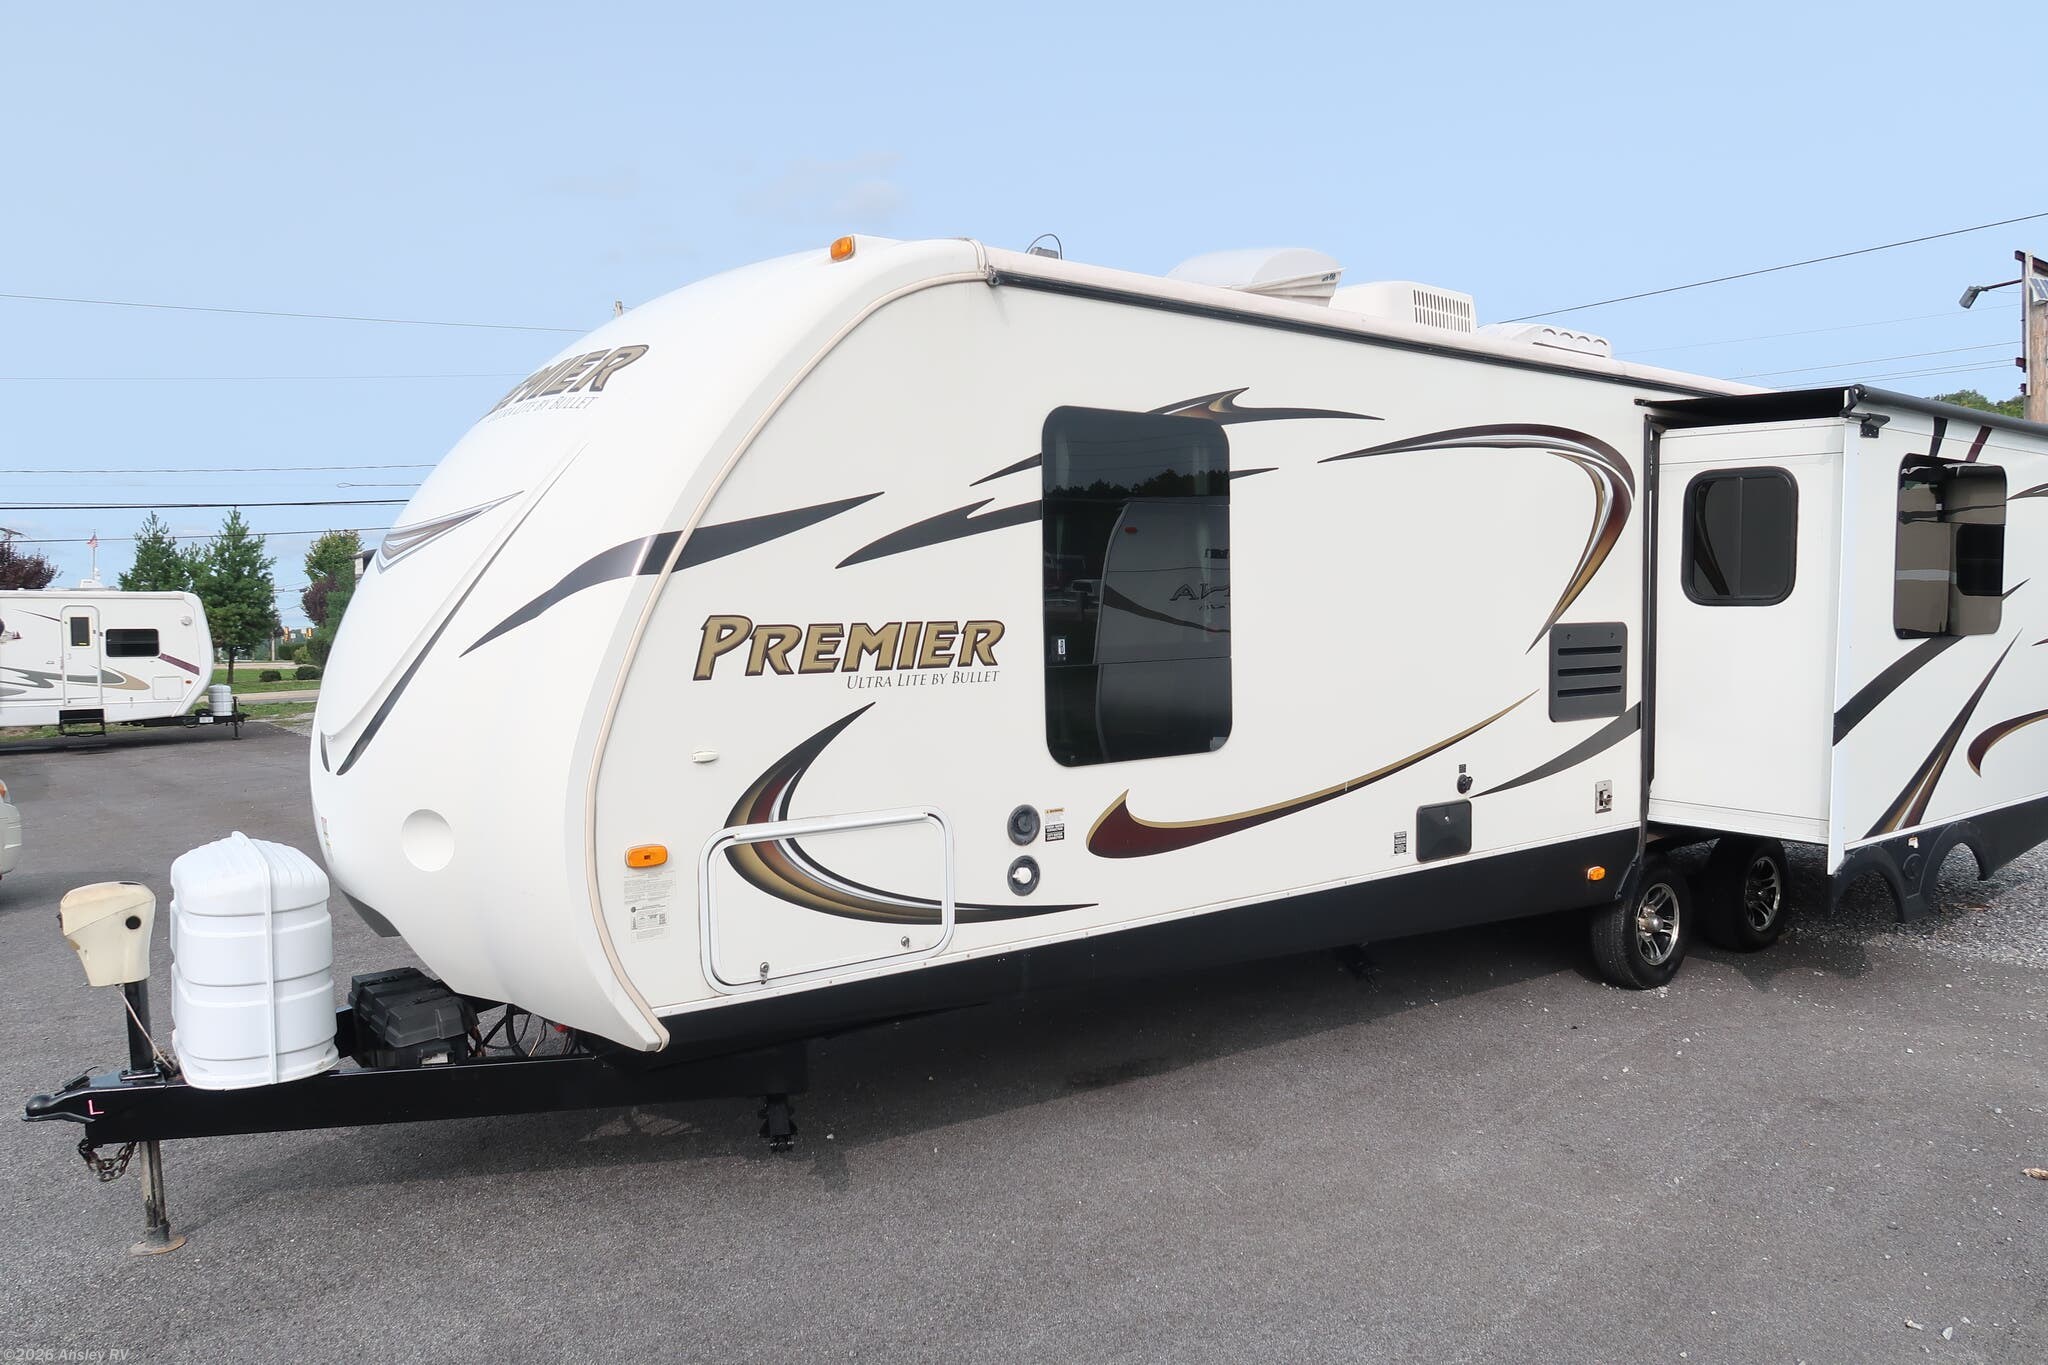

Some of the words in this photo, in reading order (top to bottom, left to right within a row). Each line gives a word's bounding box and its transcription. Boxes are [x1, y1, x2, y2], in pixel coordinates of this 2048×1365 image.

[692, 614, 1006, 682] PREMIER
[847, 675, 892, 689] ULTRA
[897, 672, 928, 687] LITE
[931, 672, 948, 685] BY
[952, 670, 1001, 684] BULLET
